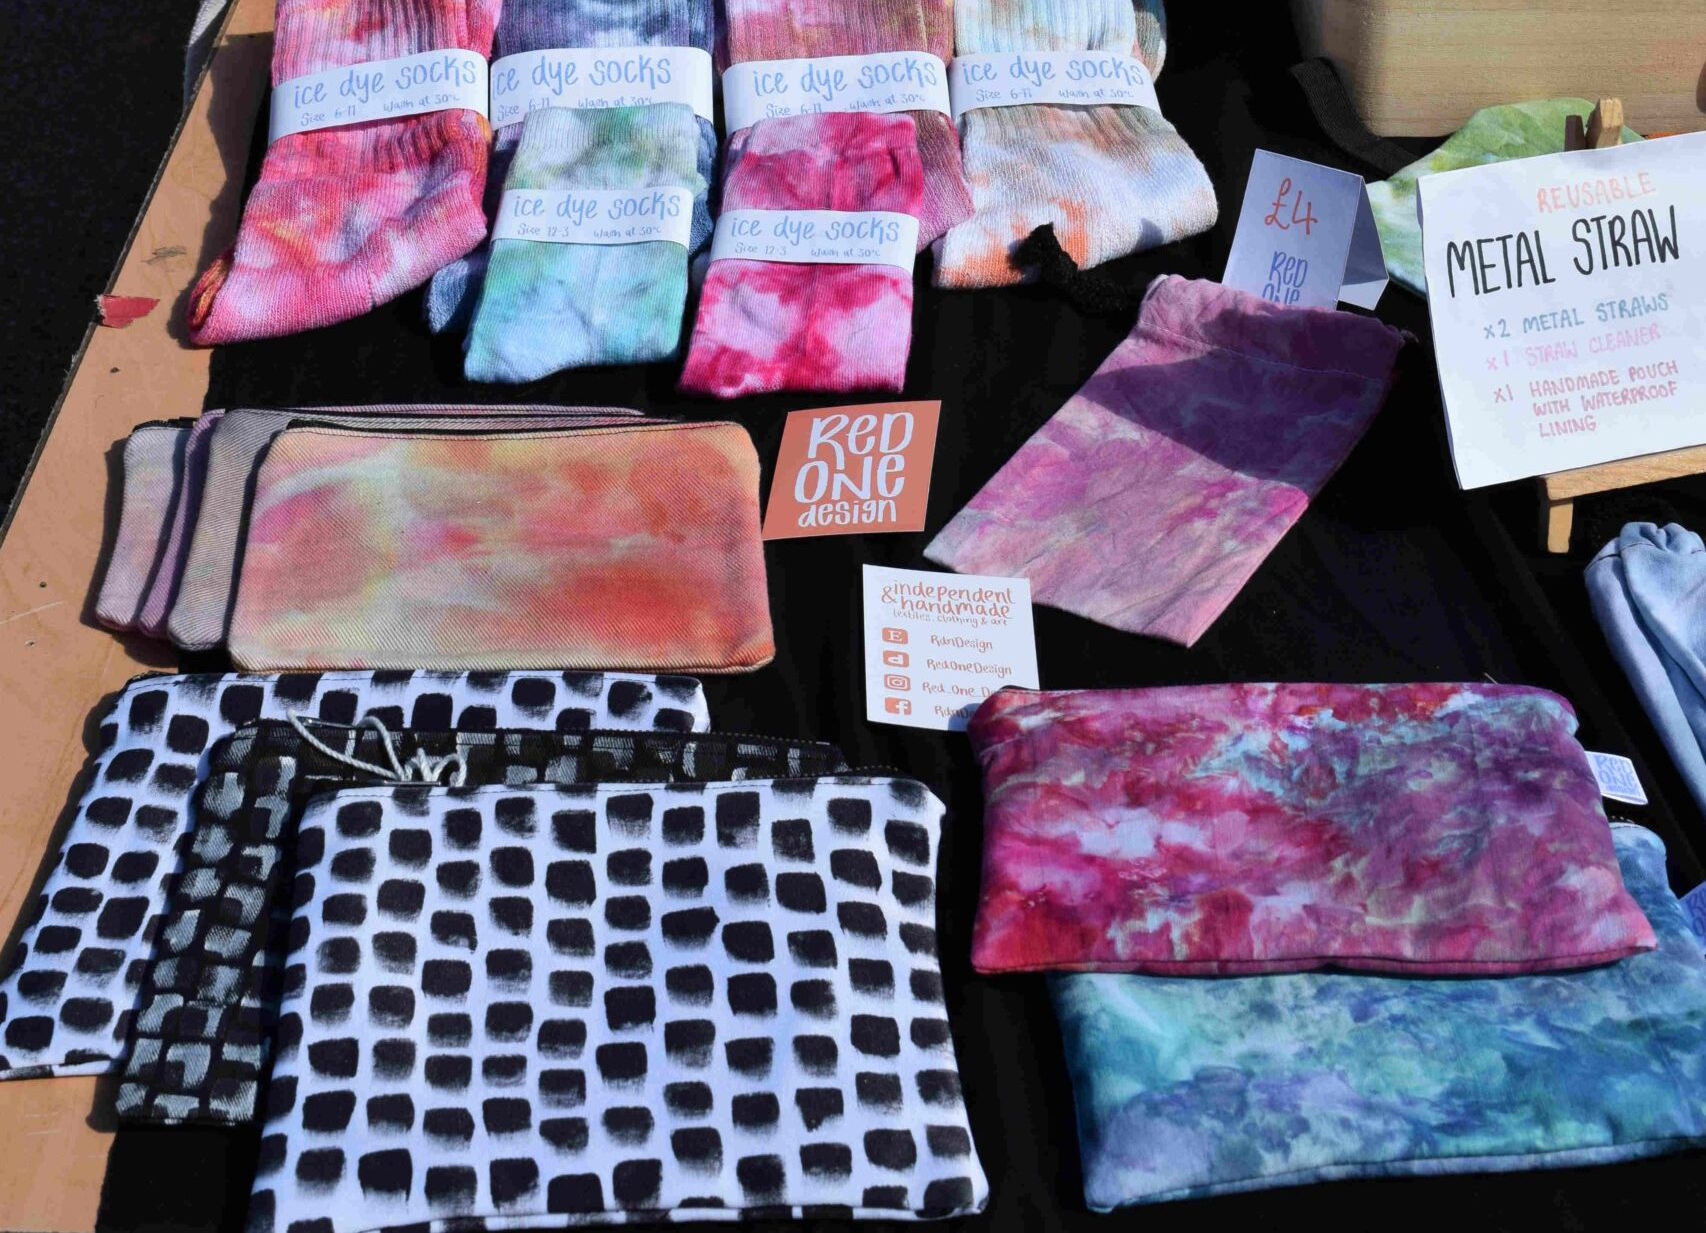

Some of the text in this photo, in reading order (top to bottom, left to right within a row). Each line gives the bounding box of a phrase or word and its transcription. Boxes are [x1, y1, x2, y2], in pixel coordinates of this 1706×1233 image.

[295, 56, 476, 108] ice dye socks
[532, 56, 578, 95] dye
[589, 55, 671, 89] socks
[753, 58, 937, 101] ice dye socks
[962, 56, 1144, 86] ice dye socks
[498, 104, 519, 121] Size
[766, 103, 791, 117] Size
[976, 89, 1000, 102] Size
[301, 113, 325, 126] Size
[514, 191, 681, 226] ice dye socks
[1265, 178, 1318, 235] £4
[1537, 172, 1656, 212] REUSABLE
[731, 216, 899, 246] ice dye socks
[1447, 205, 1679, 297] METAL STRAW
[1523, 308, 1584, 334] METAL
[1596, 293, 1668, 323] STRAWS
[1526, 341, 1578, 367] STRAW
[1589, 323, 1660, 353] CLEANER
[1530, 369, 1620, 398] HANDMADE
[1629, 360, 1678, 381] POUCH
[1534, 381, 1678, 416] WITH WATERPROOF
[1540, 416, 1596, 438] LINING
[798, 500, 896, 527] design
[895, 581, 1016, 604] independent
[901, 596, 1013, 619] handmade
